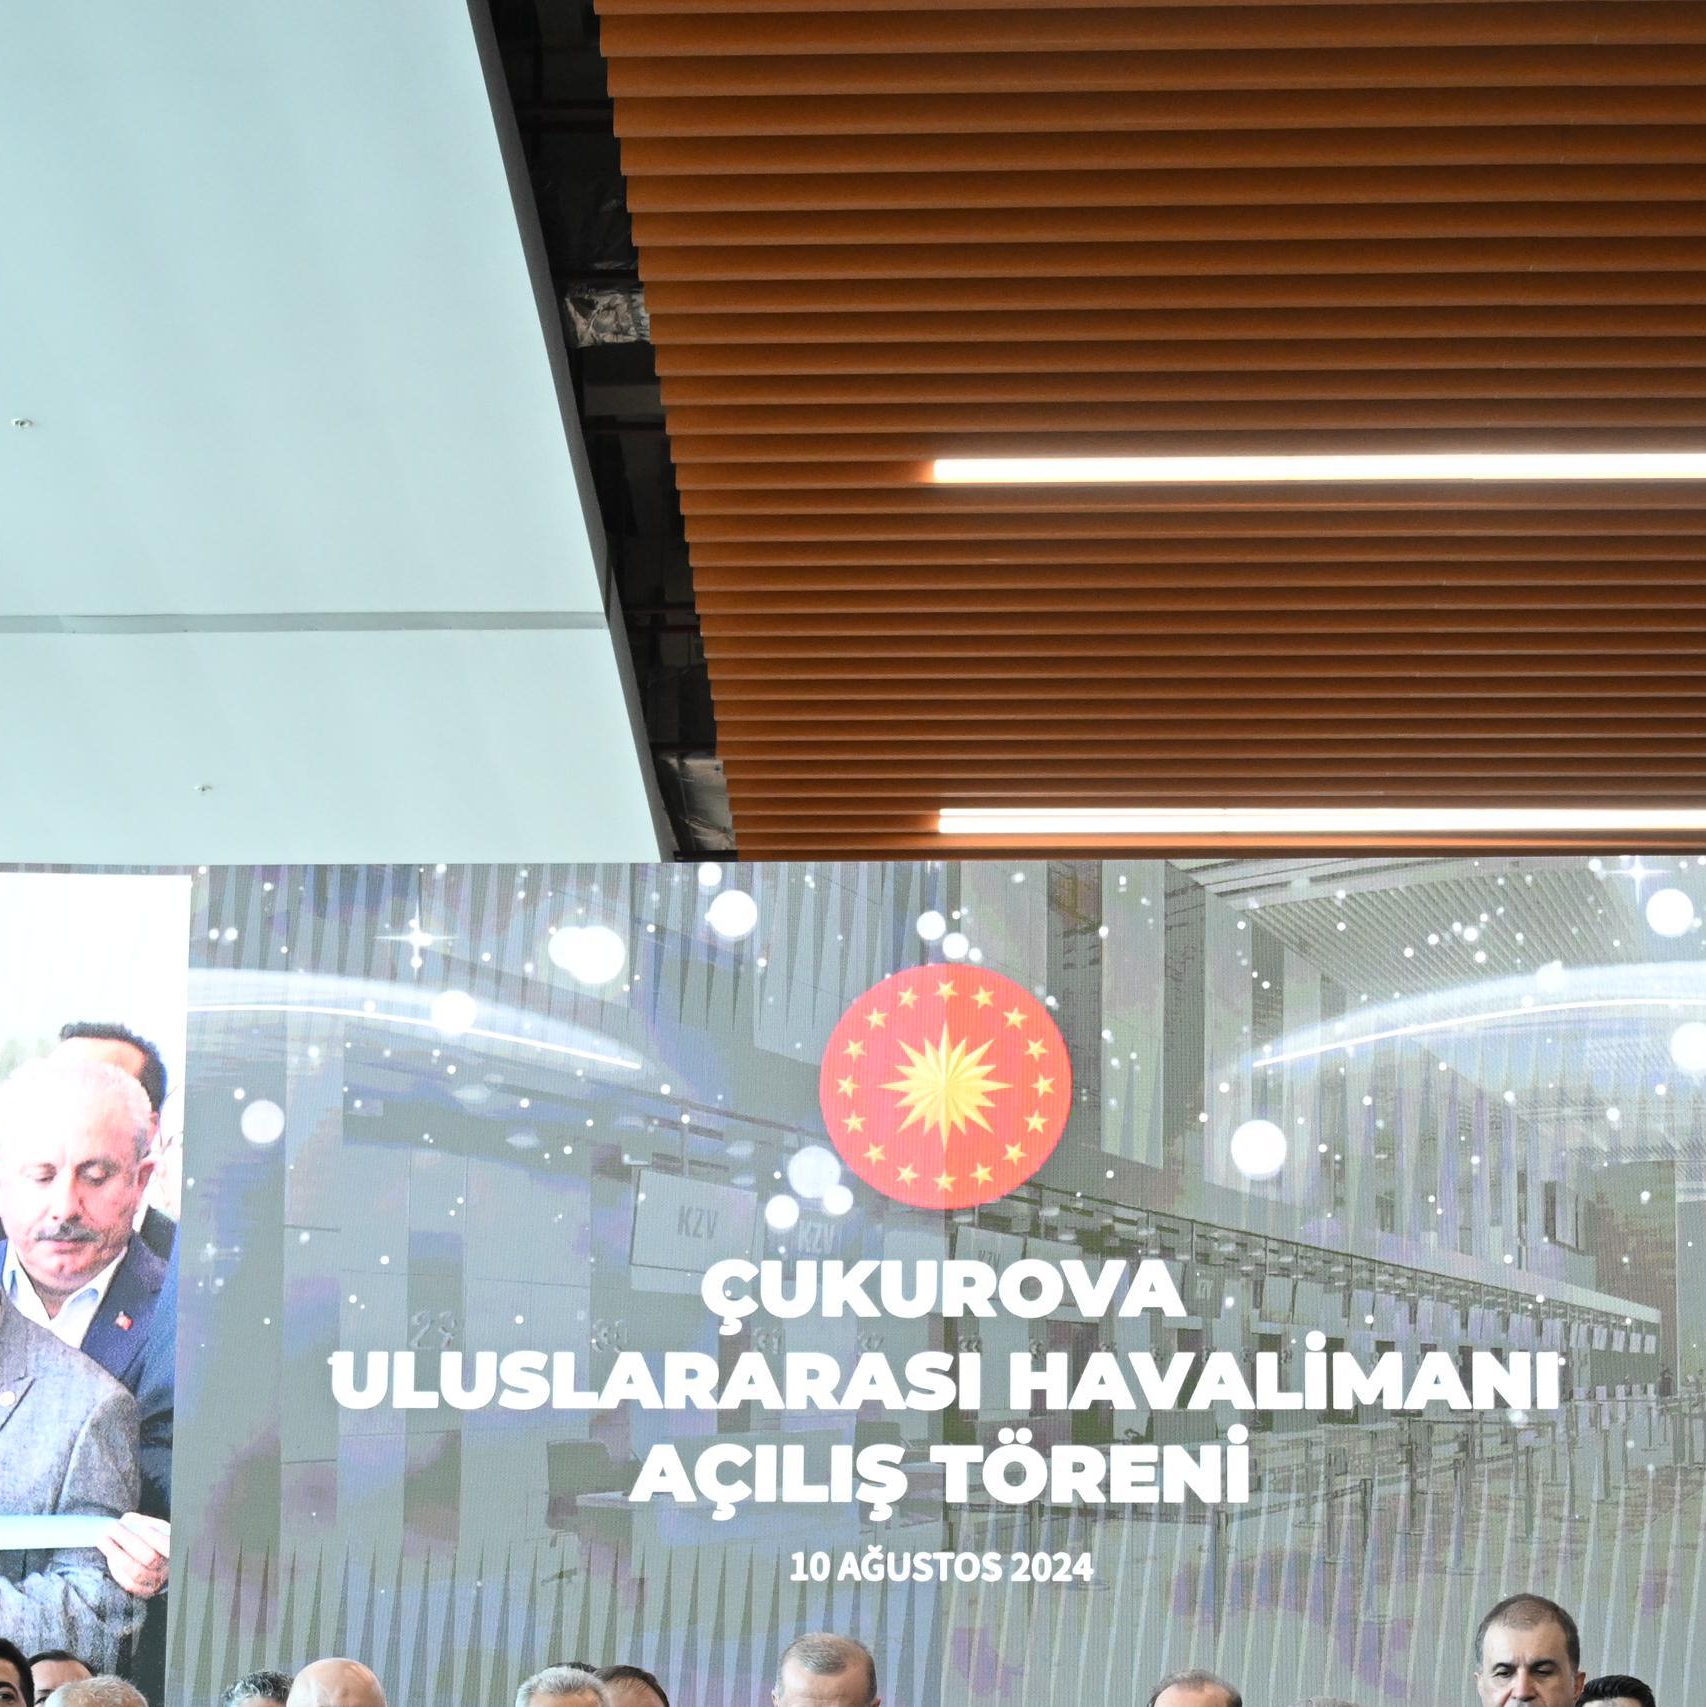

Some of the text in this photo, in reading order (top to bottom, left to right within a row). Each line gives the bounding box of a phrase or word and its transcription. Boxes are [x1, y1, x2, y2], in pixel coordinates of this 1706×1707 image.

[678, 1205, 719, 1240] KZV
[797, 1221, 835, 1253] KZV
[702, 1259, 1186, 1334] ÇUKUROVA
[330, 1330, 1562, 1411] ULUSLARARASI HAVALİMANI
[629, 1424, 1248, 1521] AÇILIŞ TÖRENİ
[790, 1544, 1095, 1583] 10 AĞUSTOS 2024
